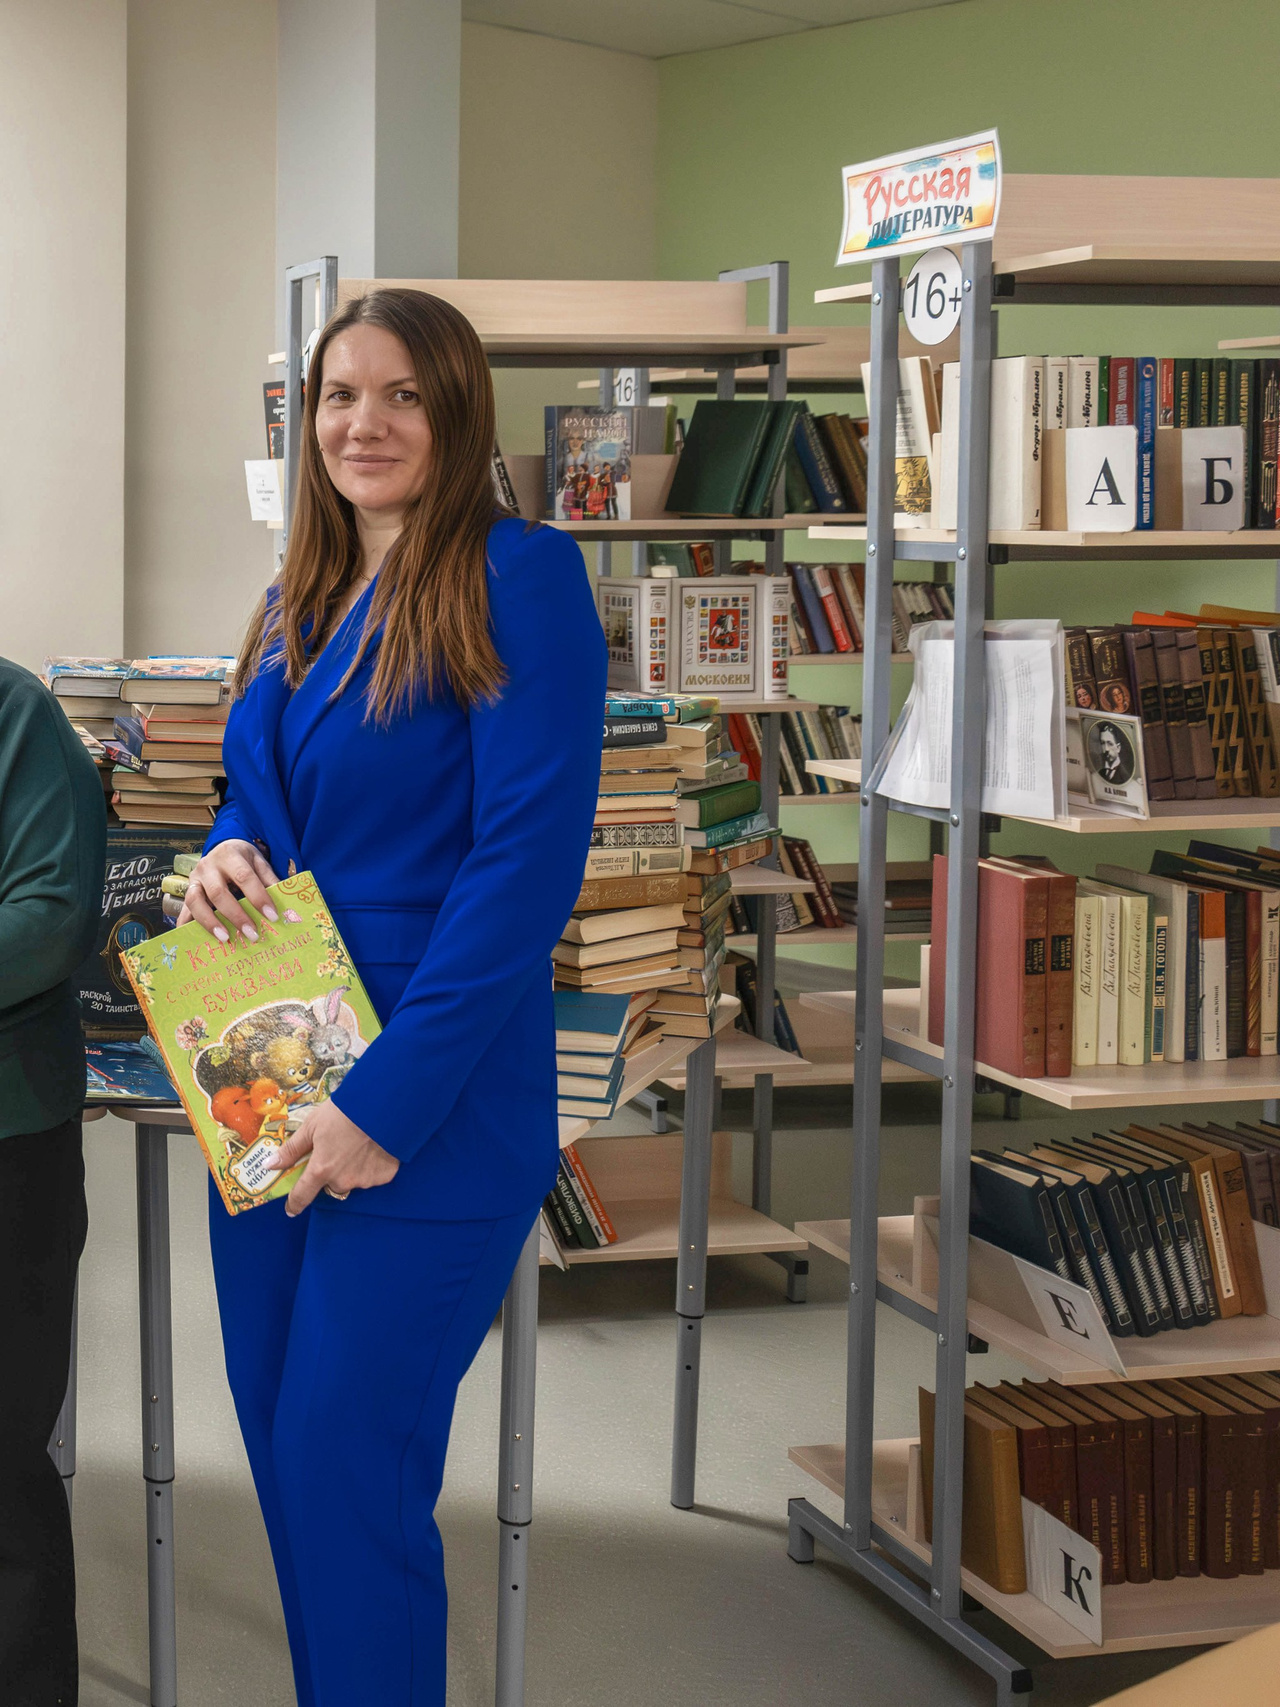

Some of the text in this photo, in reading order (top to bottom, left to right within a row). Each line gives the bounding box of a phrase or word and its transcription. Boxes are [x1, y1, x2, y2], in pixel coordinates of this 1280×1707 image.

[863, 166, 972, 226] Русская
[869, 204, 974, 242] ЛИТЕРАТУРА
[1032, 370, 1041, 424] Абрамов
[1055, 371, 1064, 425] Абрамов
[1081, 371, 1093, 424] Абрамов
[1085, 456, 1126, 506] А
[1200, 456, 1233, 505] Б
[684, 673, 751, 686] МОСКОВИЯ
[106, 856, 151, 881] ЕЛО
[101, 887, 162, 917] УБИЙСТ
[186, 918, 279, 972] КНИА
[1155, 929, 1166, 969] ГОГОЛЬ
[80, 990, 112, 1004] РАСКРОЙ
[91, 1000, 104, 1011] 20
[202, 957, 305, 1013] БУКВАМИ
[557, 1173, 582, 1225] ФИЗКУЛЬТУ
[1043, 1289, 1090, 1340] Е
[1058, 1547, 1094, 1617] К
